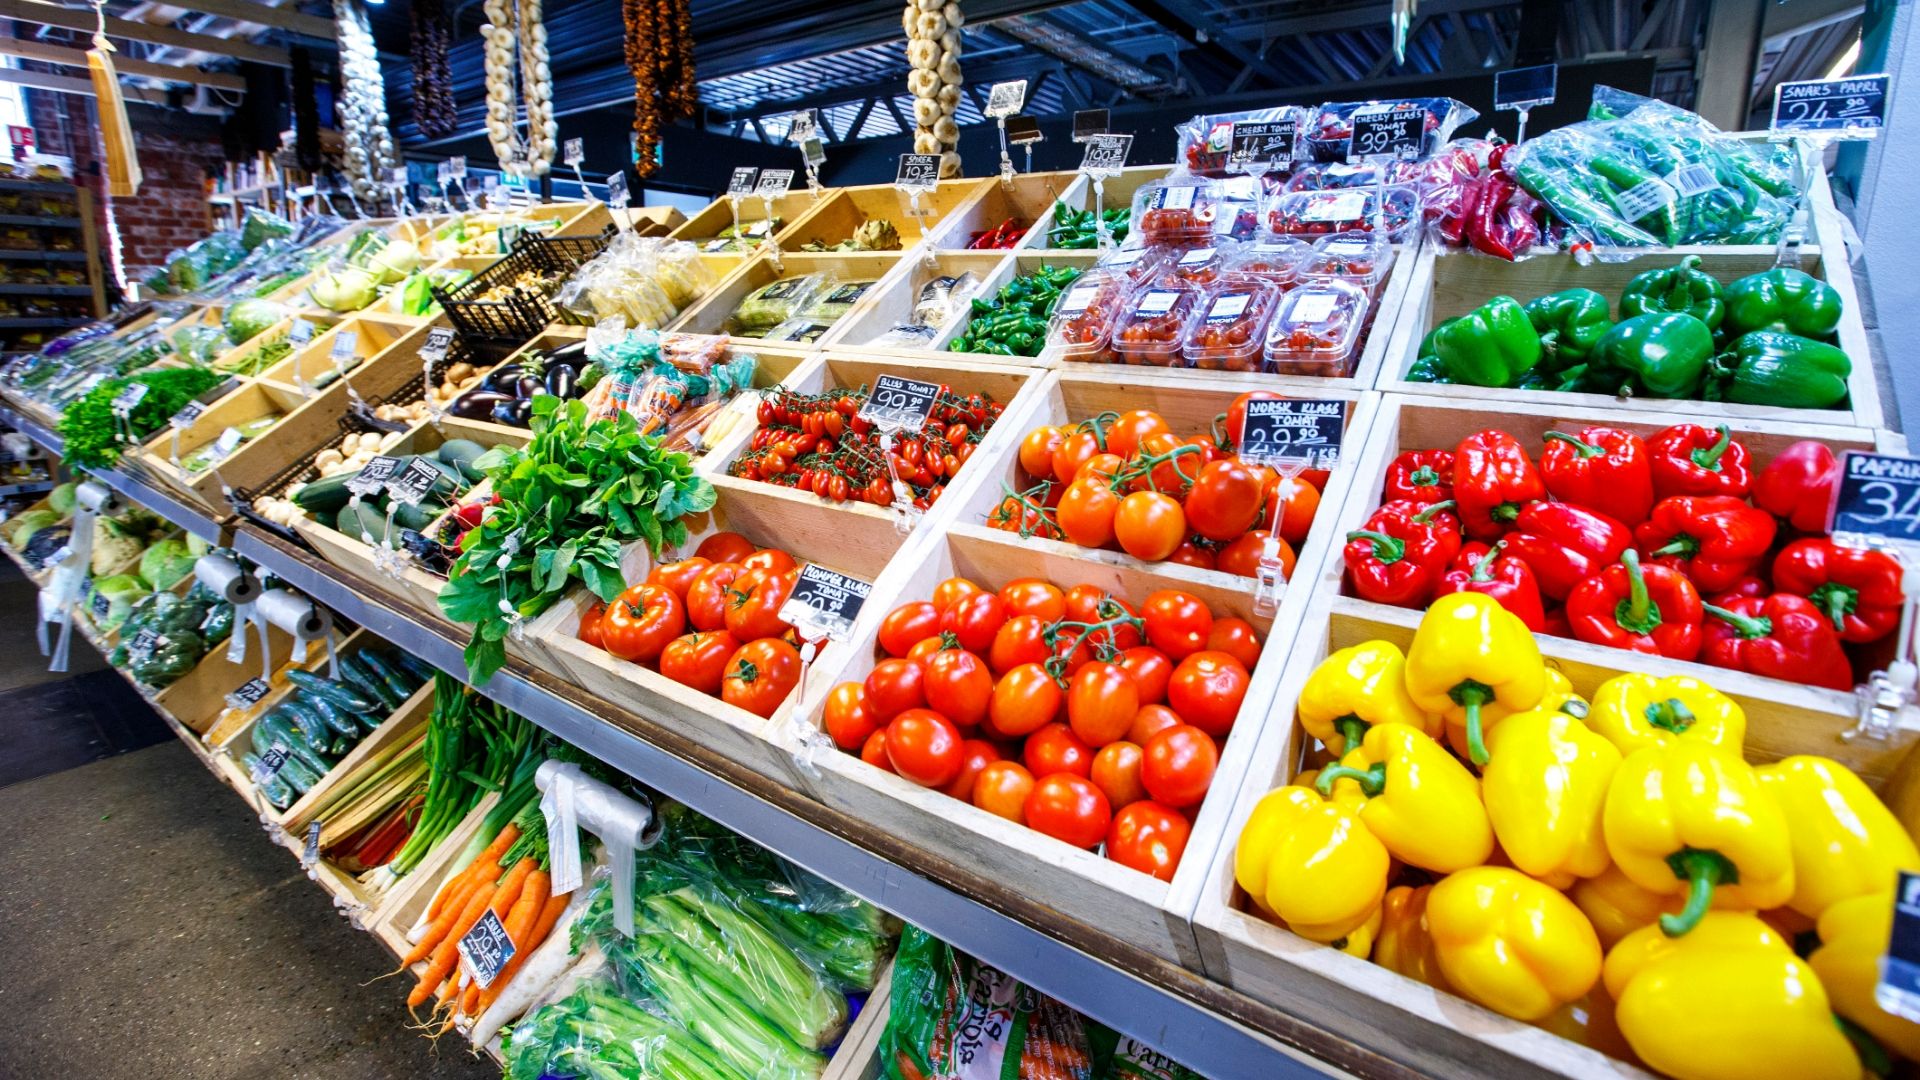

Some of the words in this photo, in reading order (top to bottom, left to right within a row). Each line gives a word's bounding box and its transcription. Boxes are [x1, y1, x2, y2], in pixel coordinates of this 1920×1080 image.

[1782, 101, 1829, 129] 24
[1845, 98, 1866, 110] 90
[1235, 125, 1267, 135] CHERRY
[1358, 131, 1389, 154] 39
[1393, 129, 1407, 140] 90
[880, 377, 903, 389] BLISS
[907, 382, 936, 396] TOMAT
[870, 390, 906, 418] 99
[909, 397, 923, 408] 90
[1249, 401, 1293, 413] NORSK
[1270, 415, 1318, 426] TOMAT
[1298, 428, 1319, 441] 90
[1847, 481, 1920, 534] 34
[816, 583, 850, 602] TOMAT
